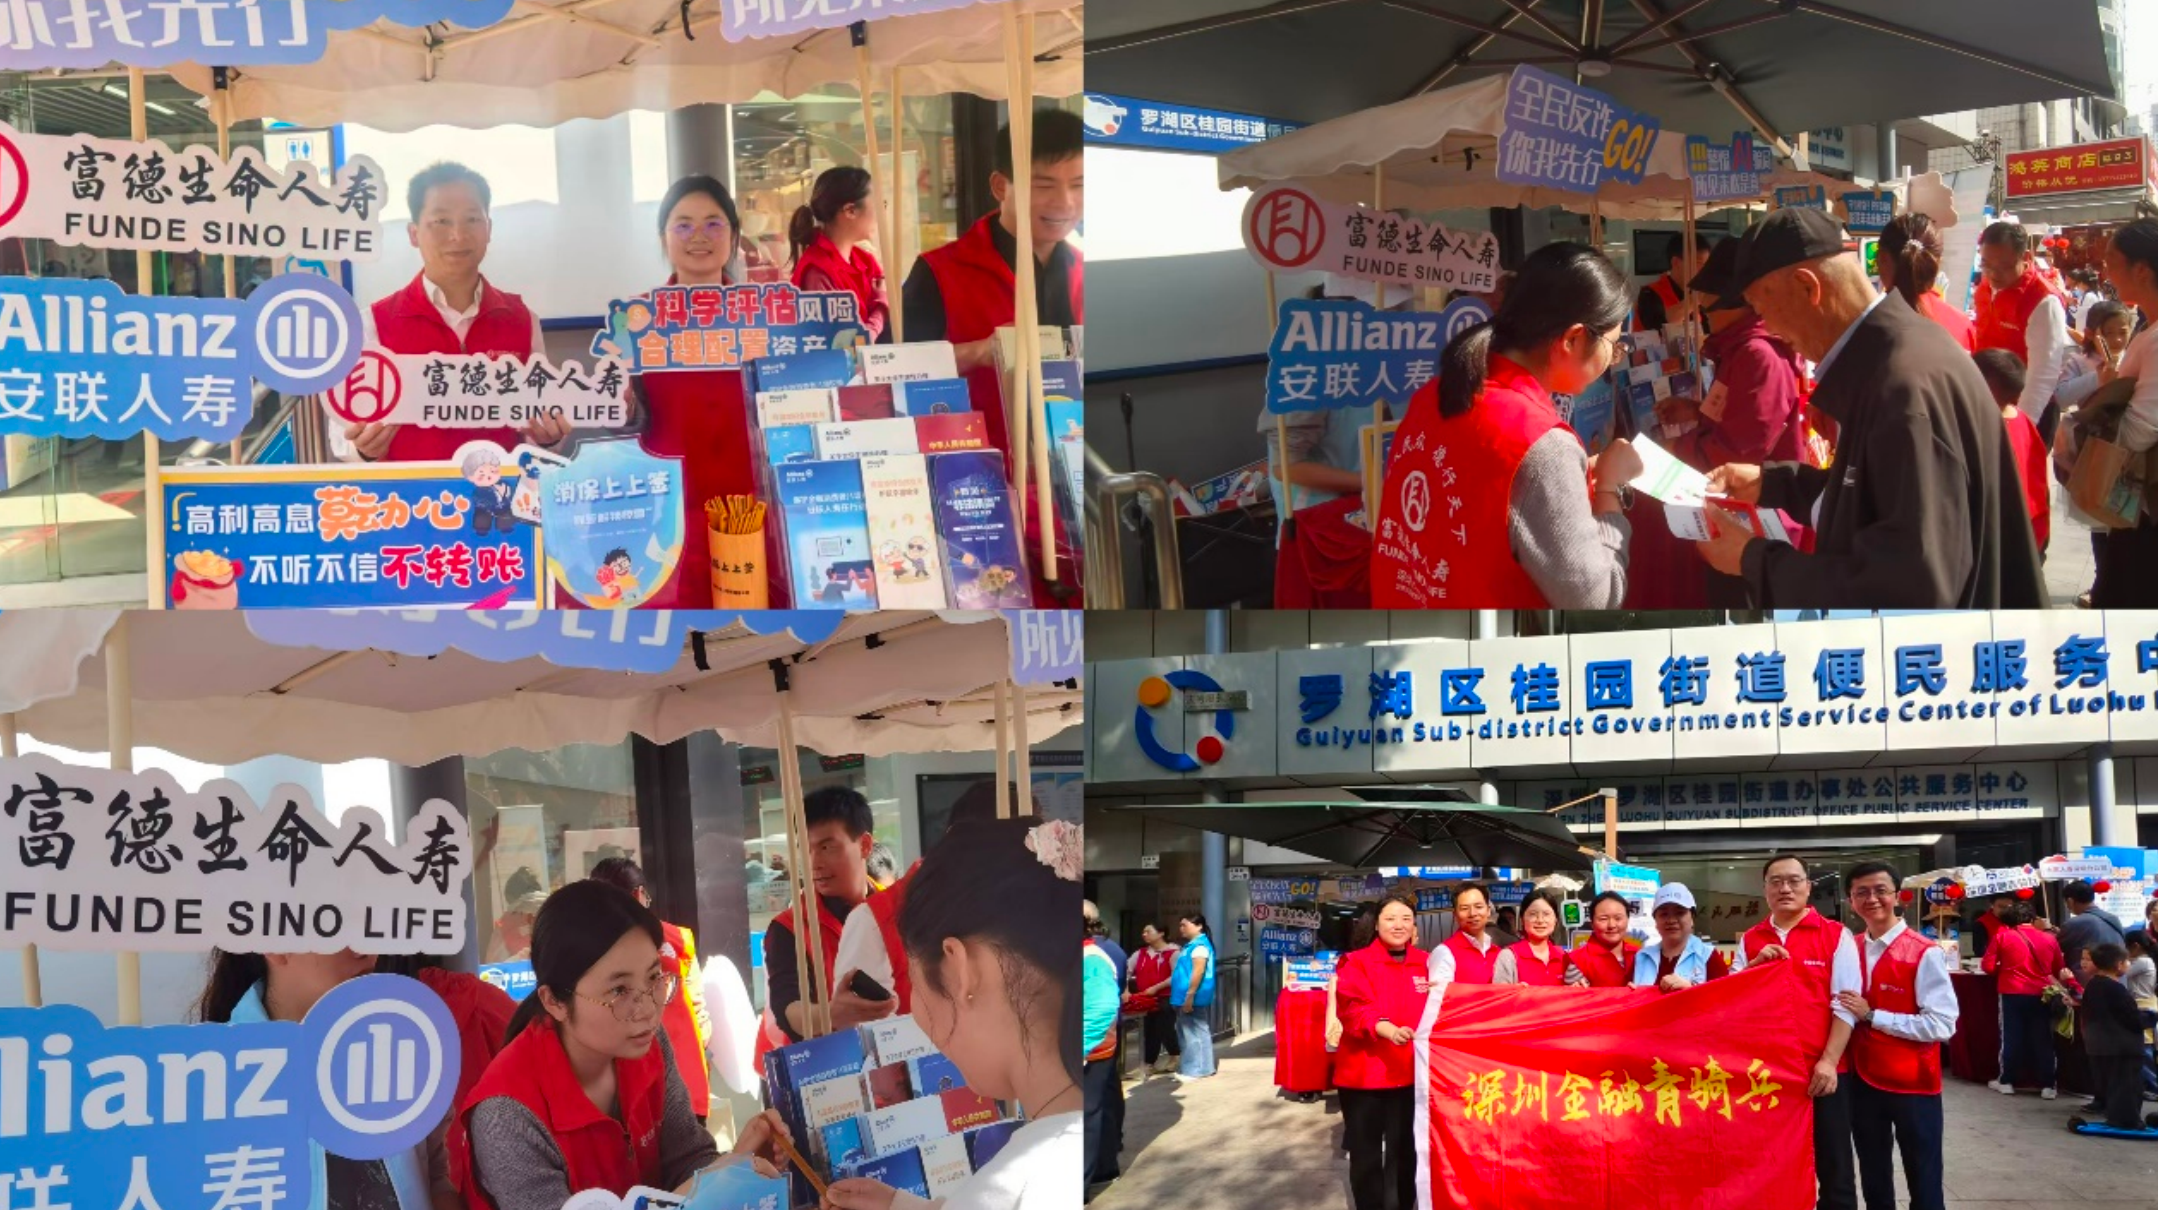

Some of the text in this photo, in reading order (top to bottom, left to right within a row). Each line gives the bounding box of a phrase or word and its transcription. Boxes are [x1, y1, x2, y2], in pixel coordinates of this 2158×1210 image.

[1511, 75, 1615, 140] 全民反诈
[1505, 130, 1604, 186] 你我先行
[1603, 119, 1655, 174] GO!
[63, 144, 378, 221] 富德生命人寿
[64, 213, 374, 253] FUNDE SINO LIFE
[1345, 211, 1497, 269] 富德生命人寿
[1343, 254, 1492, 287] FUNDE SINO LIFE
[0, 294, 237, 360] Allianz
[654, 288, 856, 328] 科学评估风险
[1280, 310, 1437, 351] Allianz
[637, 328, 828, 368] 合理配置资产
[0, 371, 236, 427] 安联人寿
[422, 358, 623, 399] 富德生命人寿
[423, 405, 500, 421] FUNDE
[572, 405, 620, 421] LIFE
[555, 470, 671, 504] 消保上上签
[186, 486, 472, 541] 高利高息莫动心
[249, 543, 524, 587] 不听不信不转账
[1296, 688, 2146, 750] Guiyuan Sub-district Government Service Center of Luohu
[1620, 810, 1661, 821] LUOHU
[1665, 807, 1720, 821] GUIYUAN
[1725, 805, 1808, 819] SUBDISTRICT
[1812, 804, 1859, 816] OFFICE
[1864, 801, 1909, 814] PUBLIC
[1915, 799, 1971, 812] SERVICE
[1976, 797, 2029, 810] CENTER
[2, 772, 461, 895] 富德生命人寿
[4, 892, 454, 940] FUNDE SINO LIFE
[1263, 930, 1297, 942] Allianz
[1461, 1055, 1783, 1128] 深圳金融青骑兵
